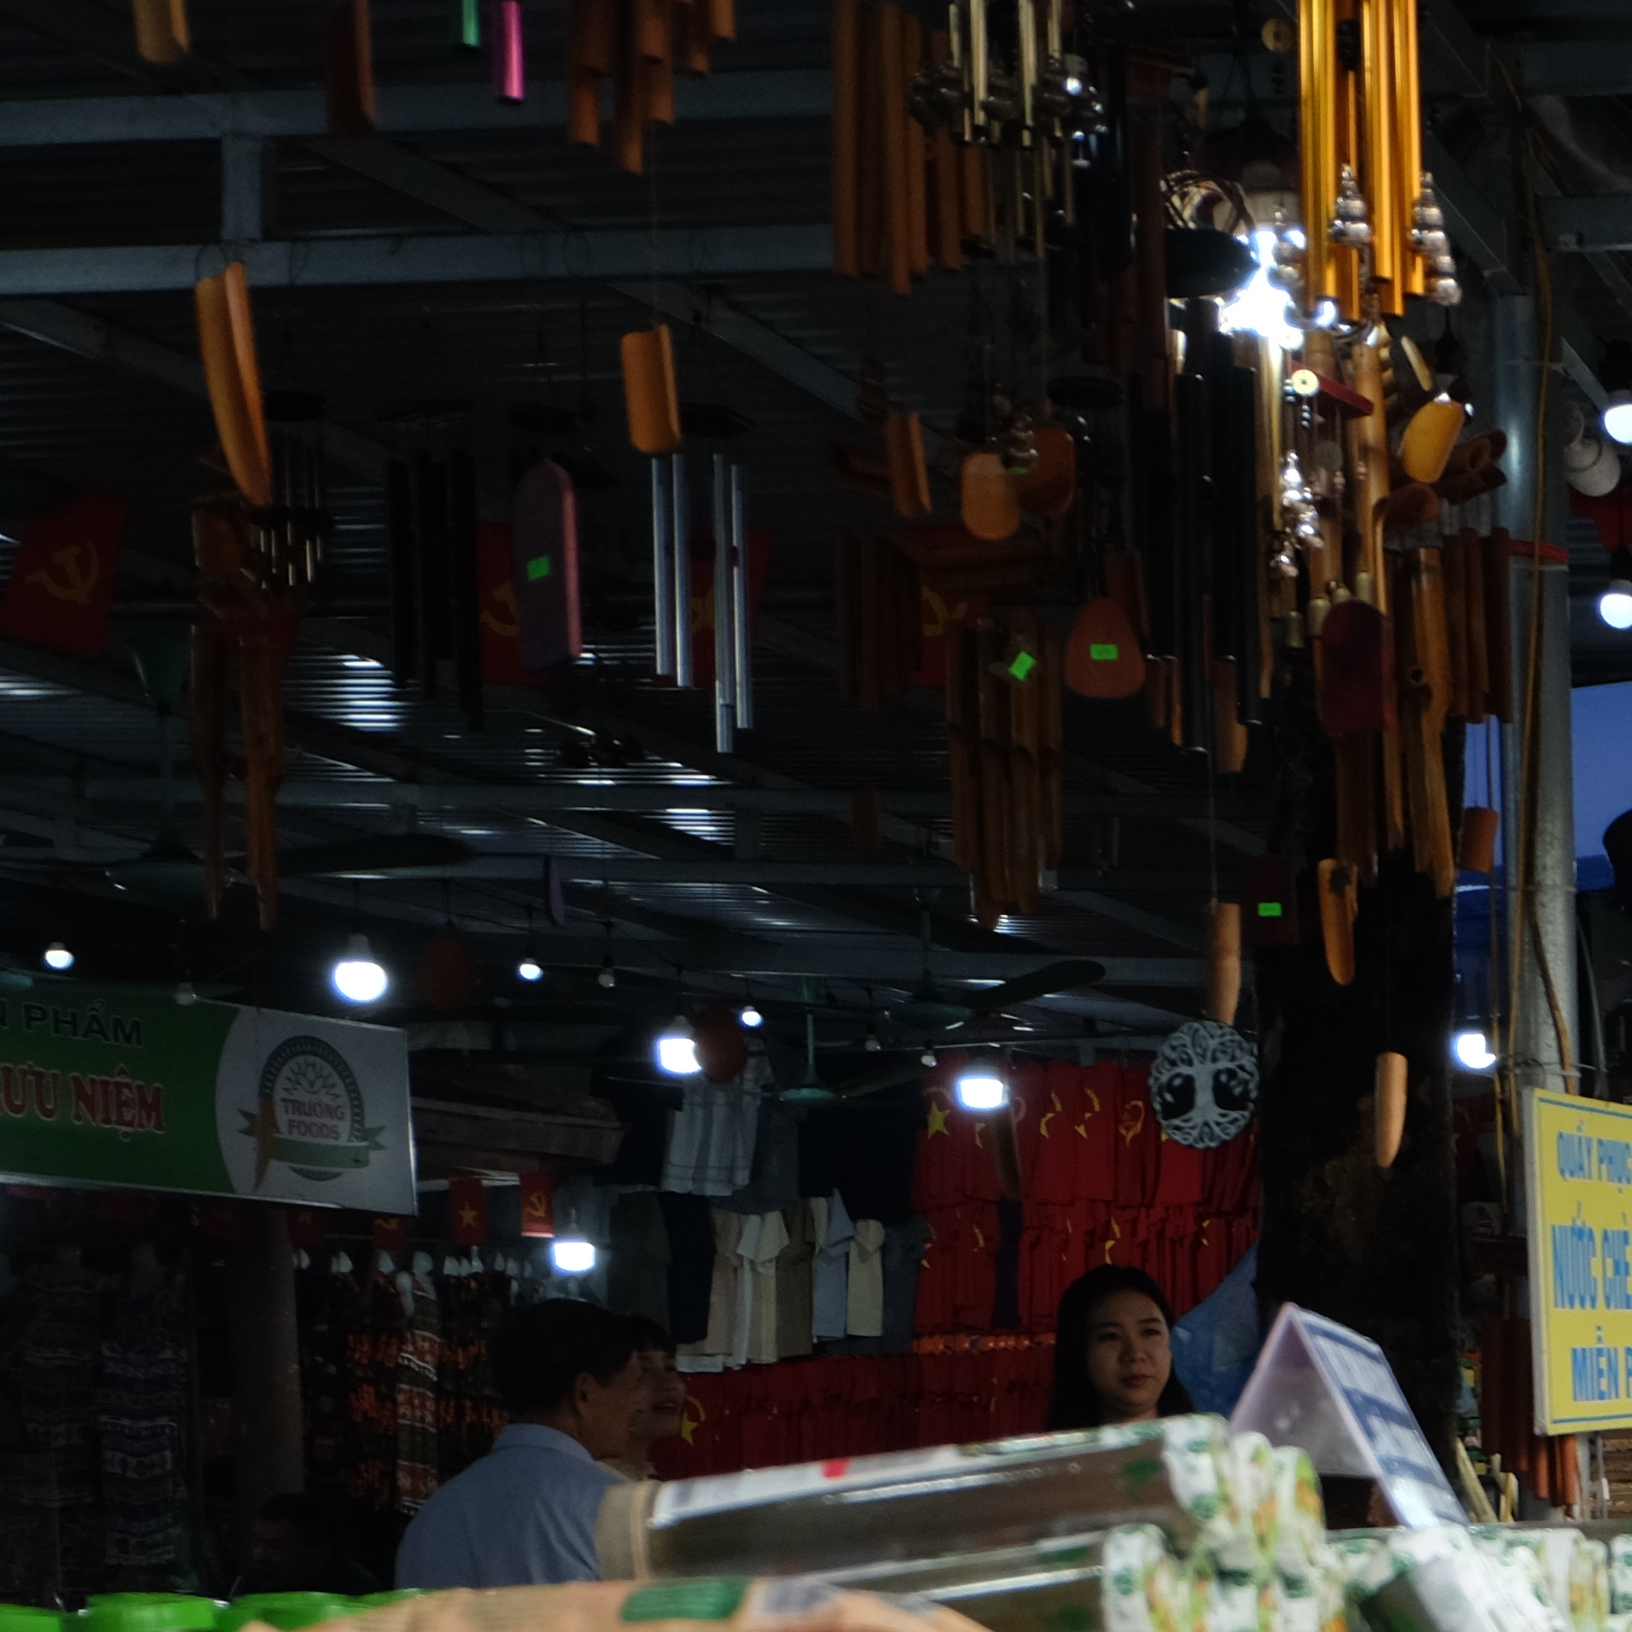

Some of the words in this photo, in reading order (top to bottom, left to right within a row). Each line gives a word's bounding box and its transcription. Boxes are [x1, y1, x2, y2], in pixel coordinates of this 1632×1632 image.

[23, 998, 144, 1048] PHẨM
[0, 1061, 60, 1120] ƯU
[71, 1064, 165, 1141] NIỆM
[280, 1093, 346, 1121] TRƯỜNG
[287, 1119, 341, 1140] FOODS
[1571, 1325, 1620, 1402] MIỄN
